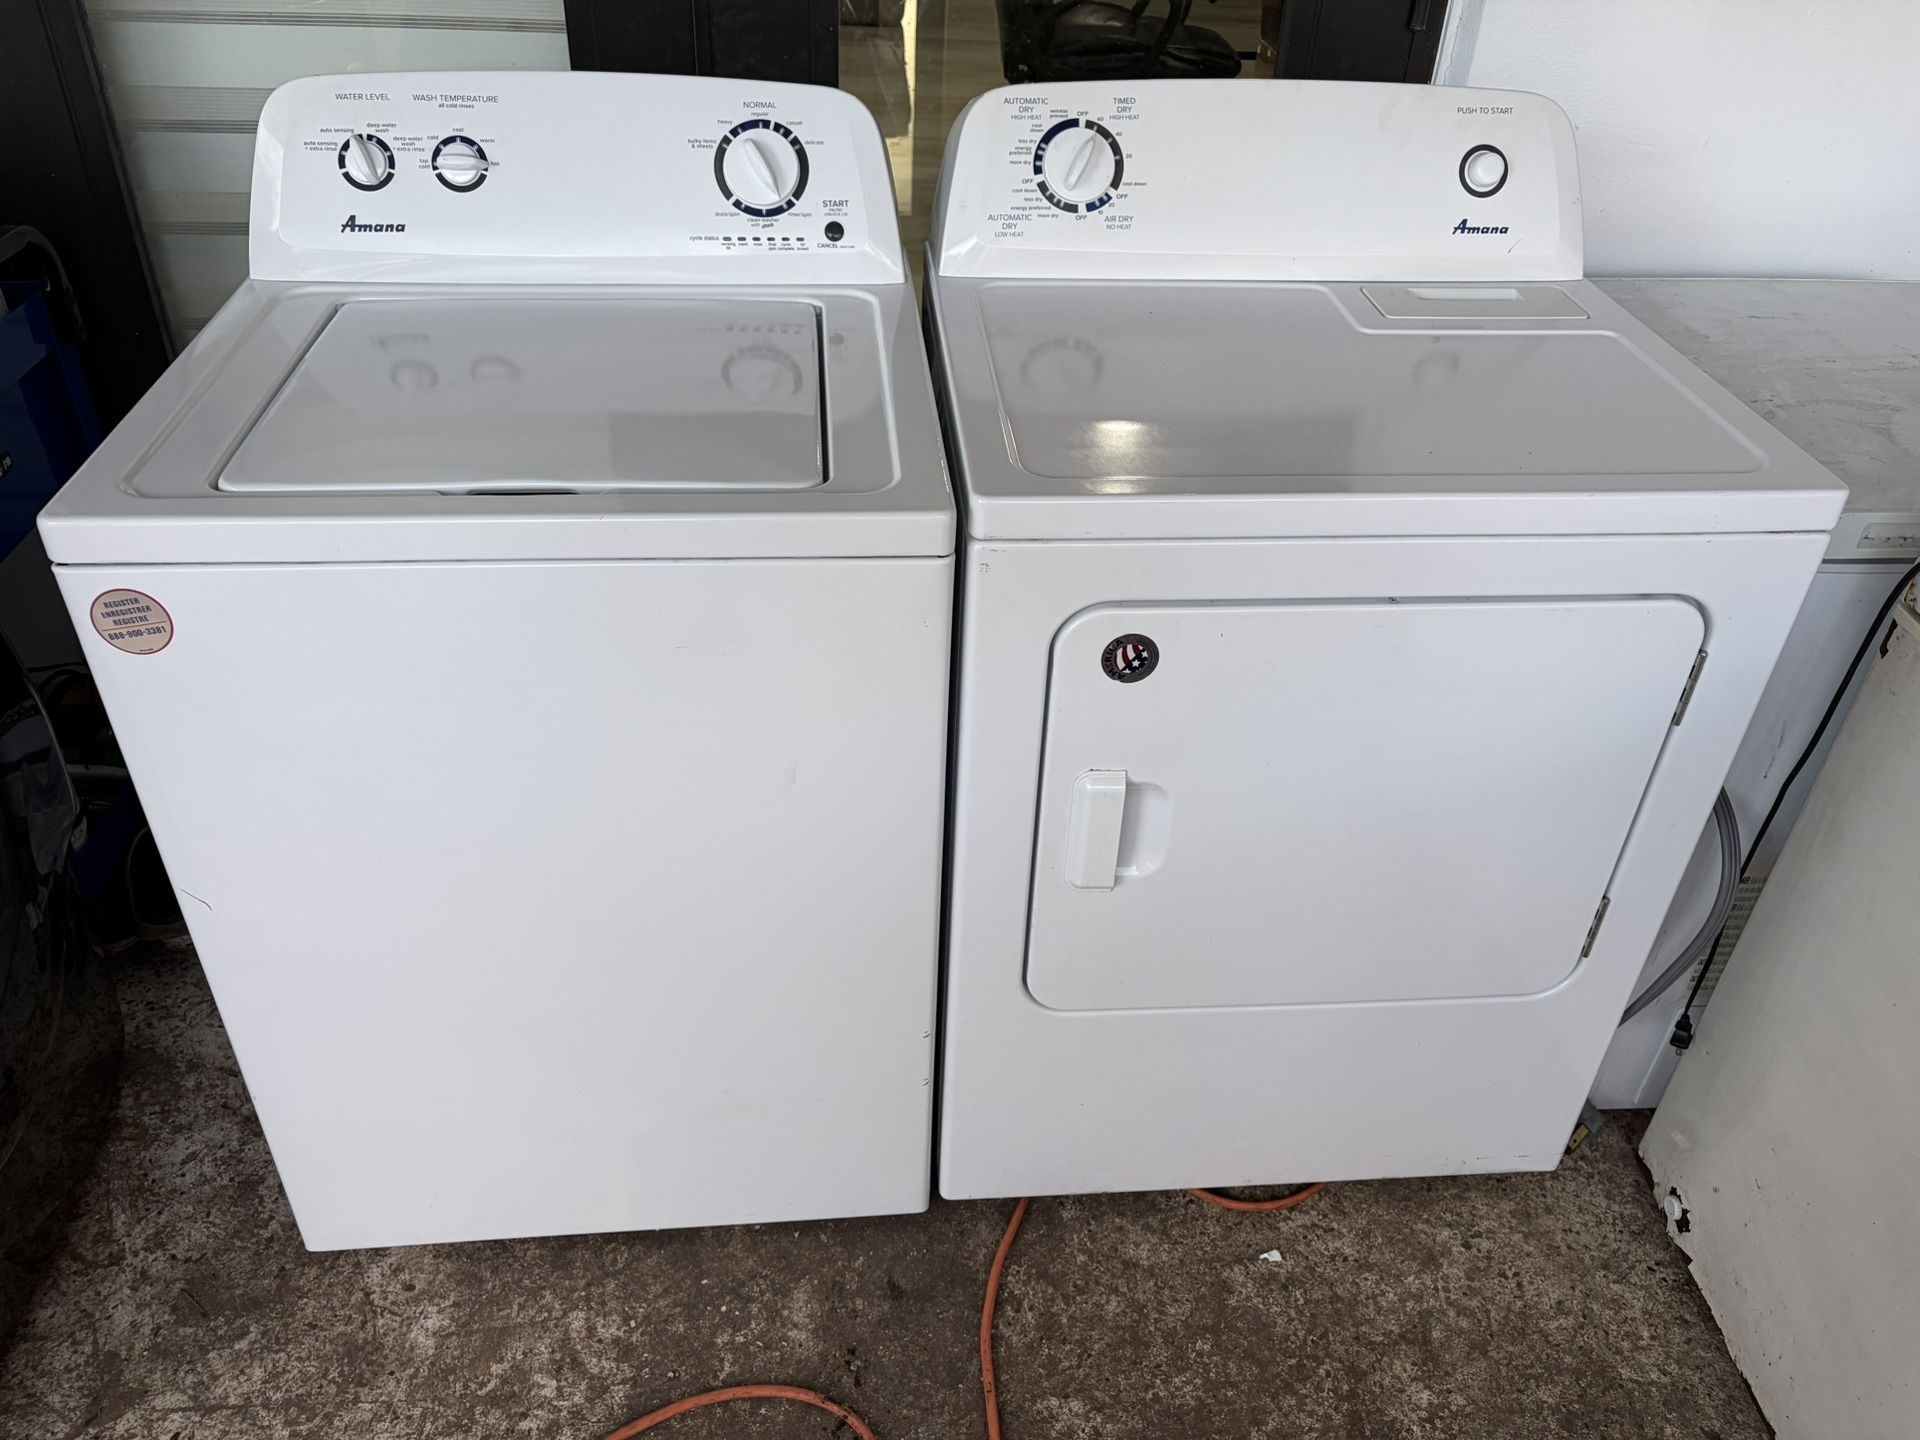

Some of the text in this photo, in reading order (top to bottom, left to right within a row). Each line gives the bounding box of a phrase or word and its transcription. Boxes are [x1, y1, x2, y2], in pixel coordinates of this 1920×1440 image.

[440, 94, 498, 103] TEMPERATURE
[340, 214, 406, 233] Amana
[1452, 218, 1509, 235] Amana
[103, 597, 140, 609] REGISTER
[101, 605, 152, 619] ENREGISTRER
[113, 615, 149, 626] REGISTRE
[108, 626, 167, 641] 888-900-3381
